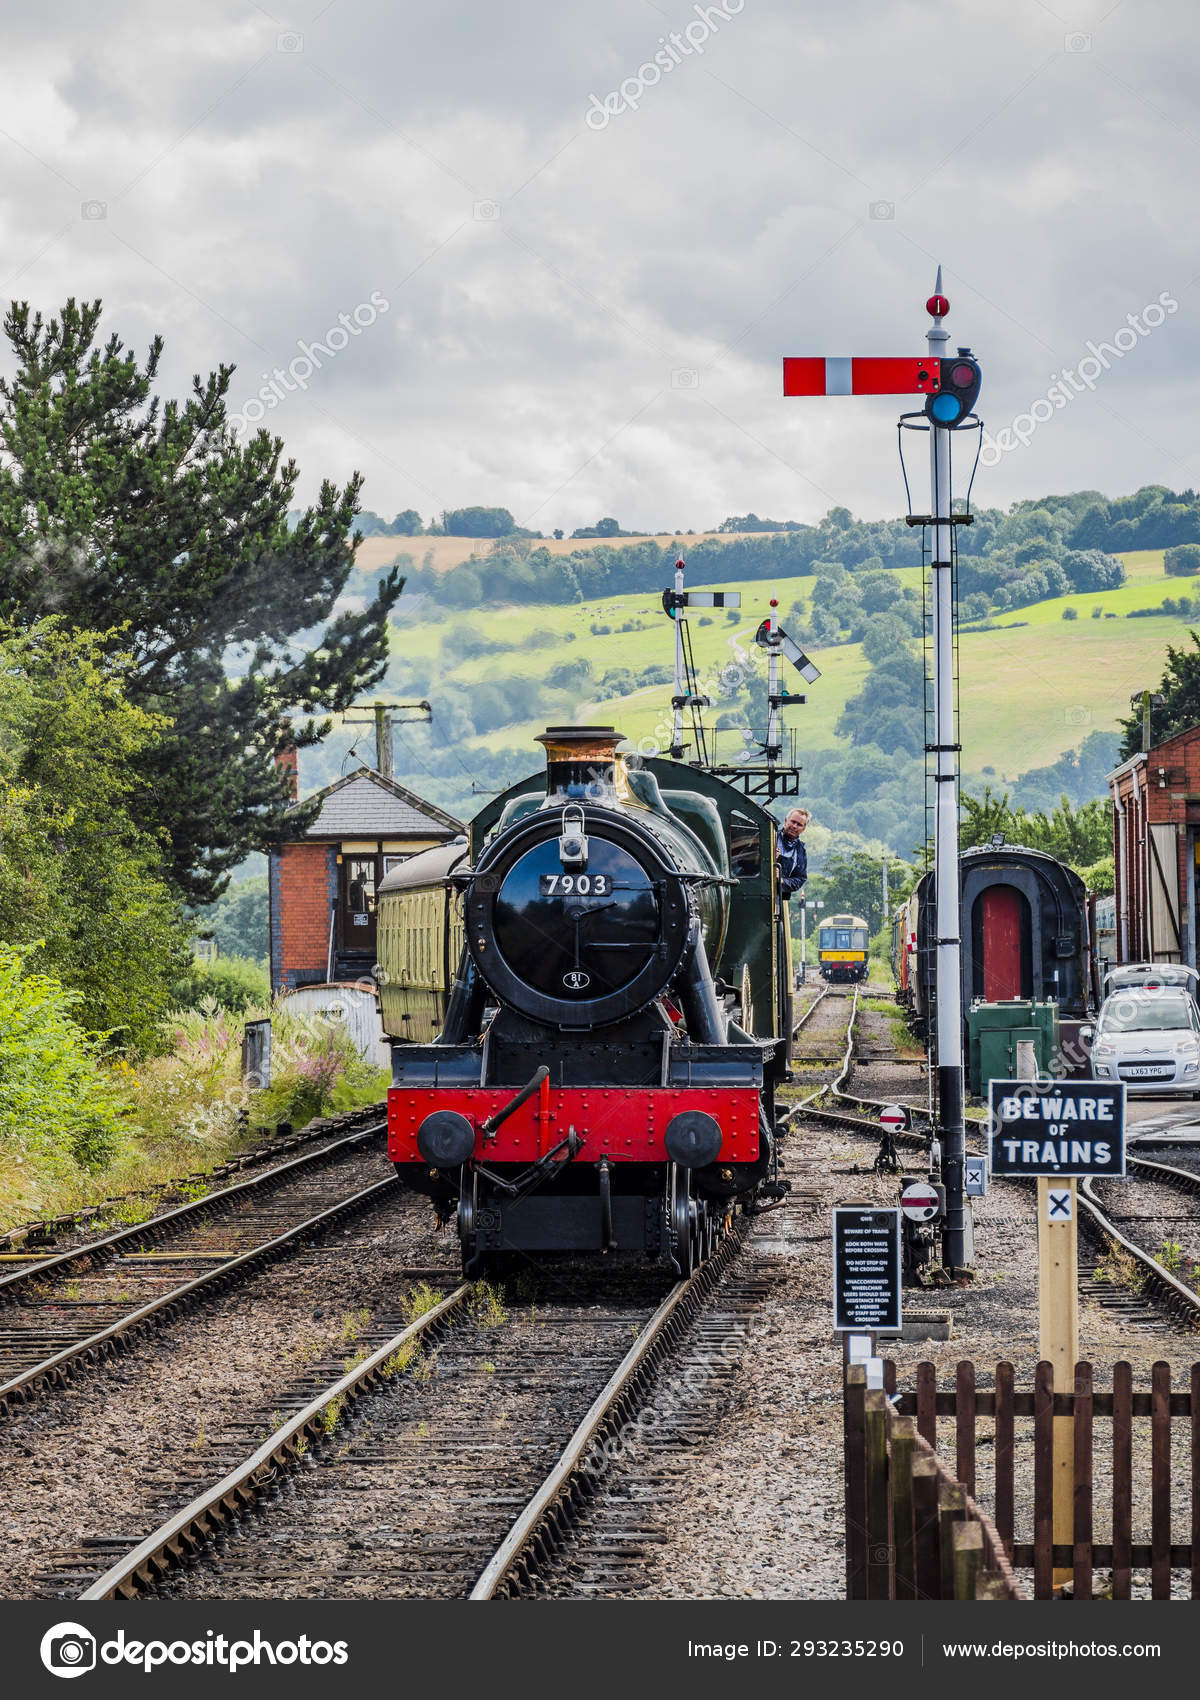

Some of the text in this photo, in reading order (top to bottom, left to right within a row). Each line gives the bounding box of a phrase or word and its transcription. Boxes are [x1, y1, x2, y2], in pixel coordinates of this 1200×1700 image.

[546, 875, 606, 895] 7903
[571, 973, 581, 982] 81
[1002, 1097, 1114, 1120] BEWARE
[1048, 1124, 1069, 1136] OF
[1002, 1141, 1112, 1164] TRAINS
